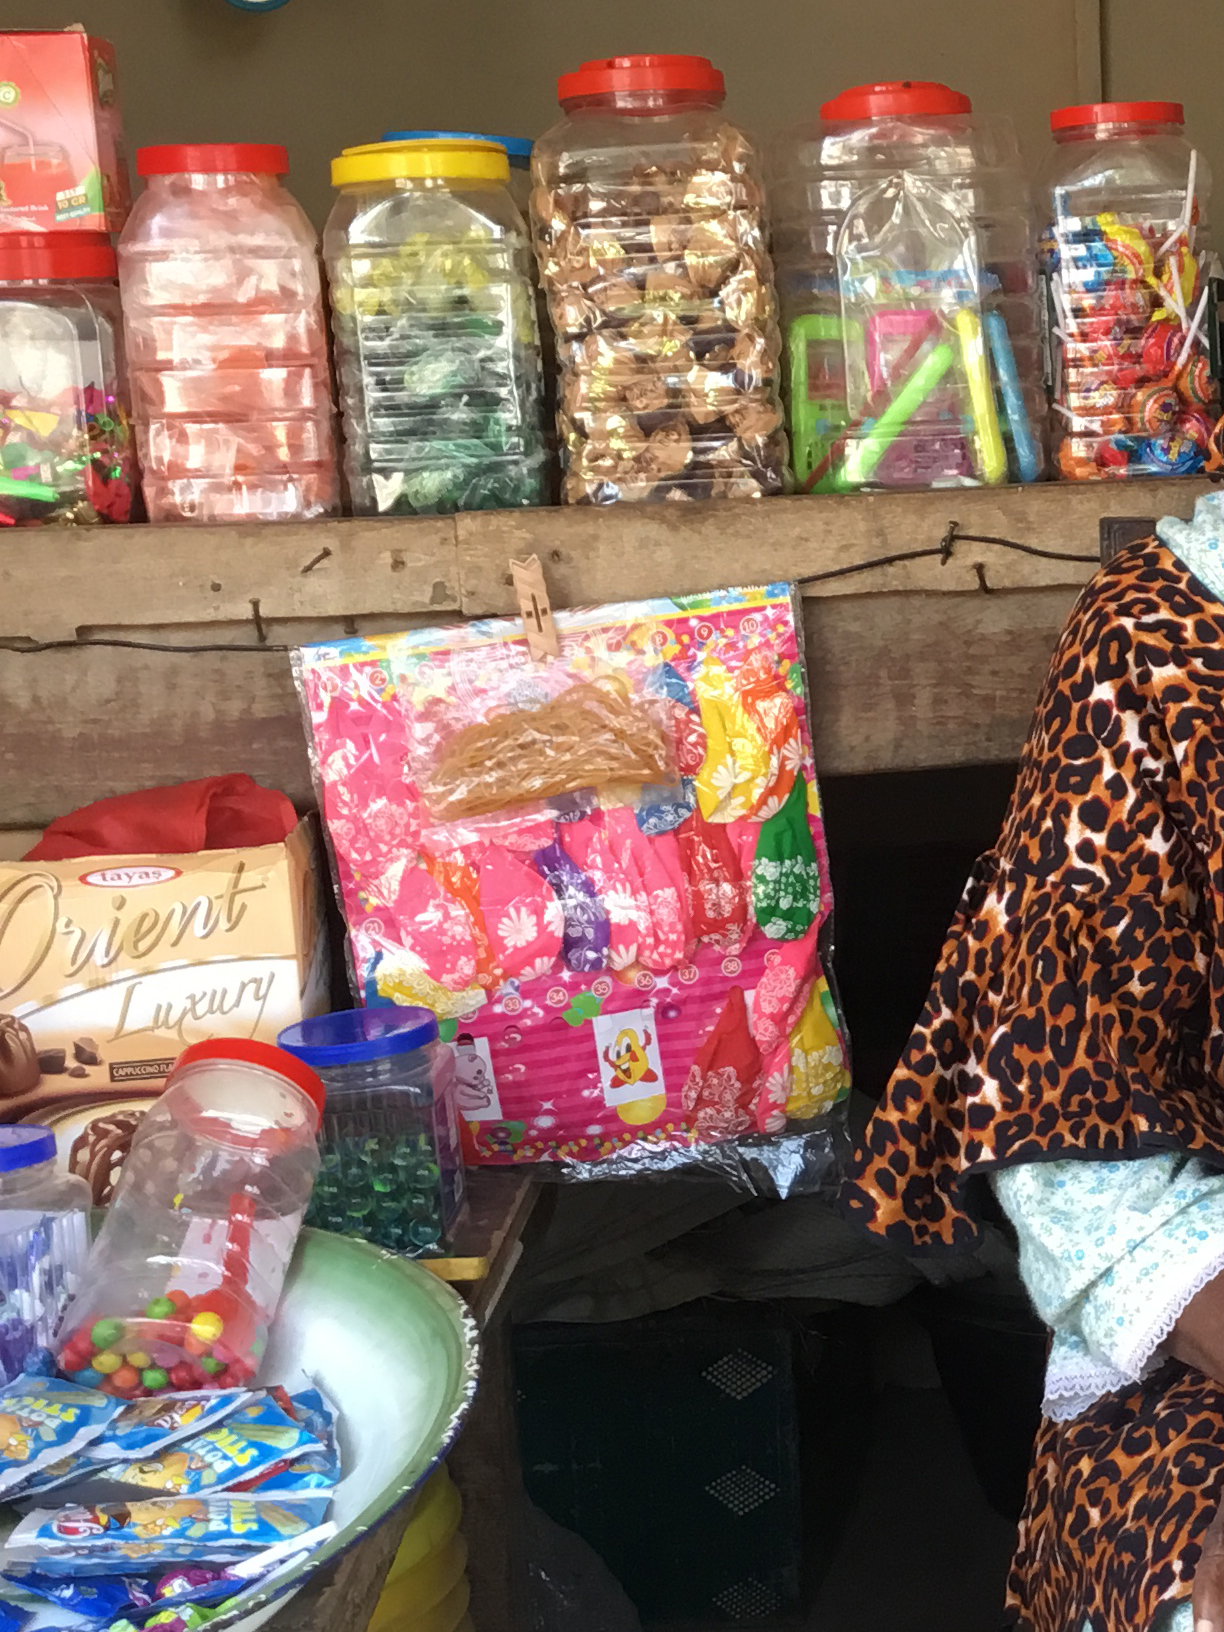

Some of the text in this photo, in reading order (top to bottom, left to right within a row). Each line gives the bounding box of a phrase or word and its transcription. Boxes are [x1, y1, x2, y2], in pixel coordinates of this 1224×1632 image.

[0, 861, 267, 999] Orient
[107, 971, 275, 1046] Luxury
[113, 1065, 159, 1077] CAPPUCCINO
